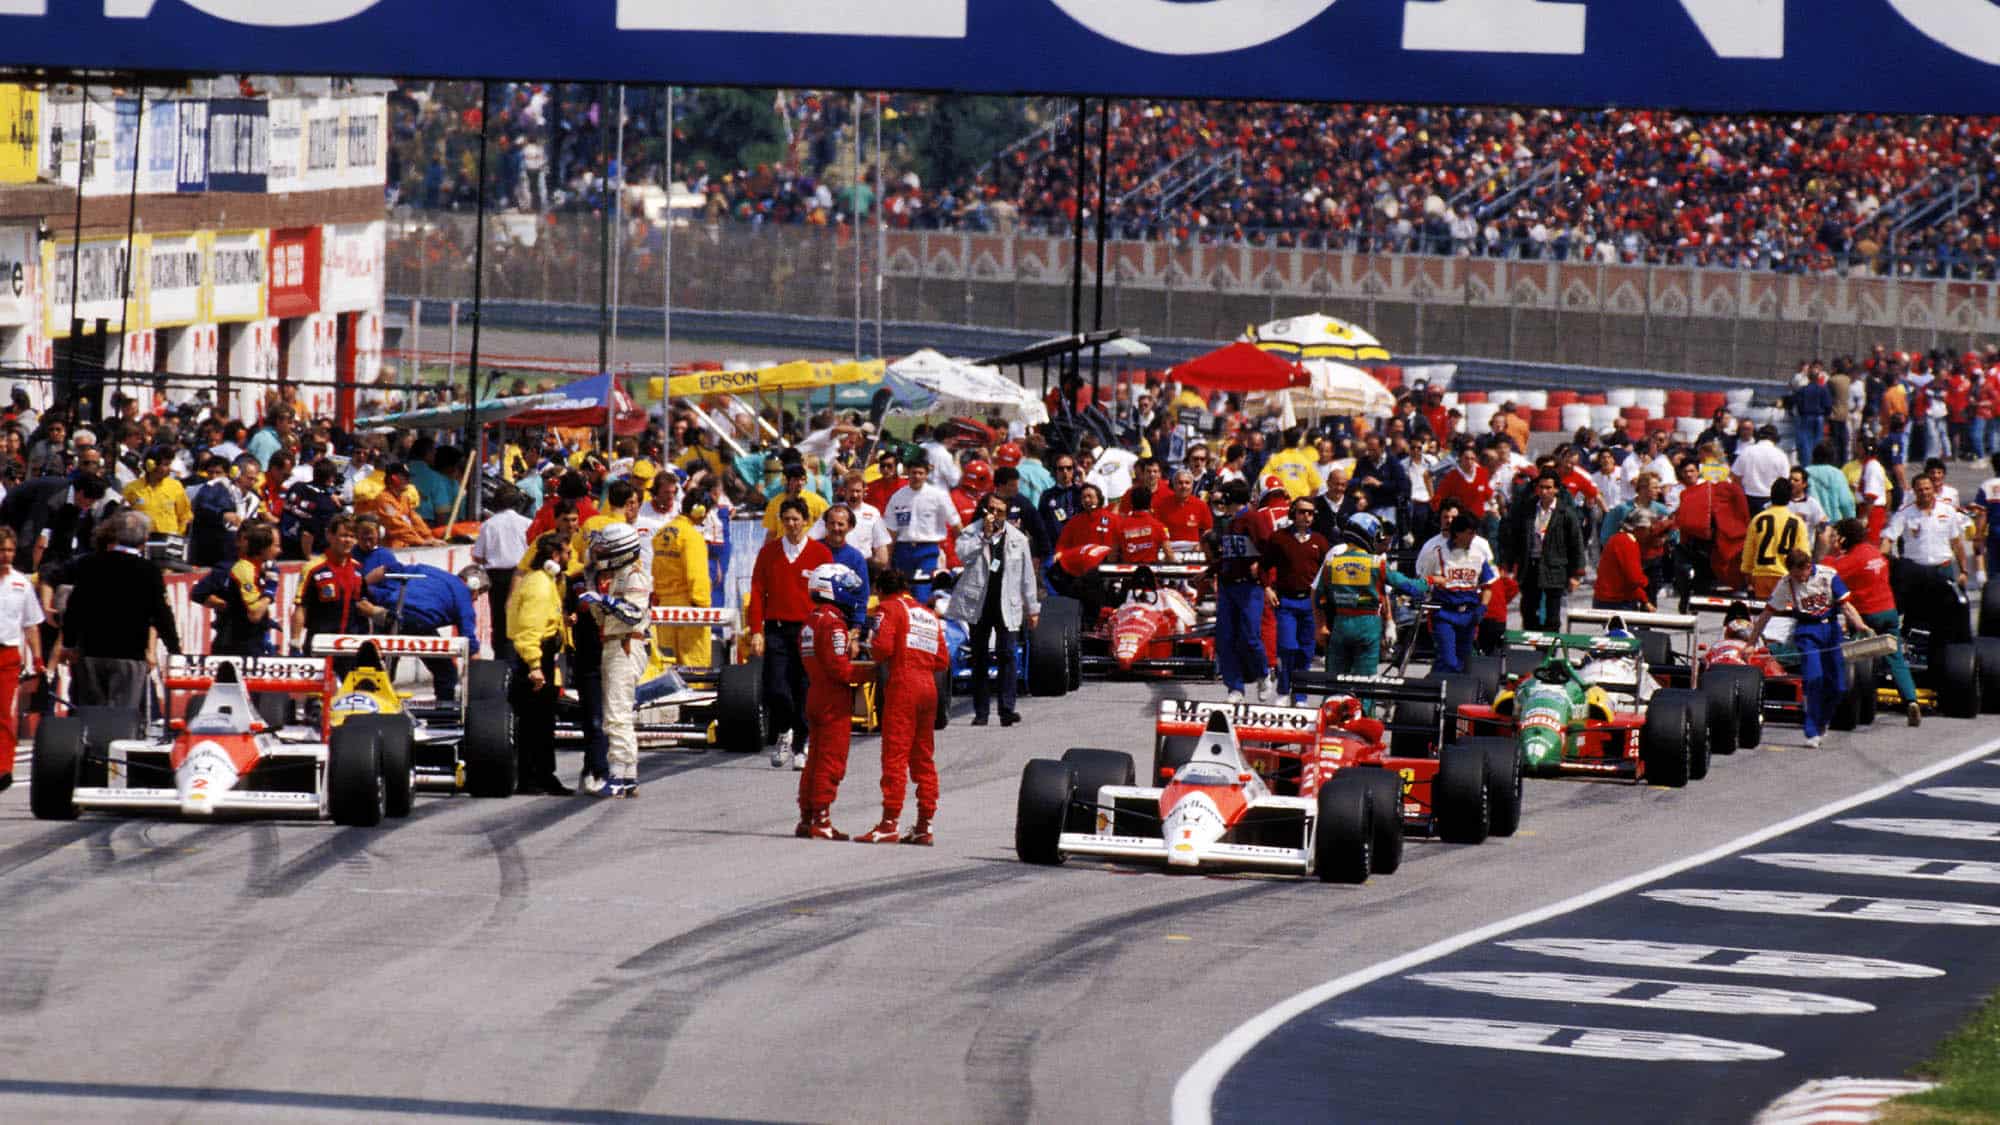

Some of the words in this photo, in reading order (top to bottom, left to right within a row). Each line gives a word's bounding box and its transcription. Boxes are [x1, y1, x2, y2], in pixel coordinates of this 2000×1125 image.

[700, 371, 758, 390] EPSON
[1756, 514, 1799, 566] 24
[650, 610, 720, 622] anon
[193, 778, 208, 789] 2
